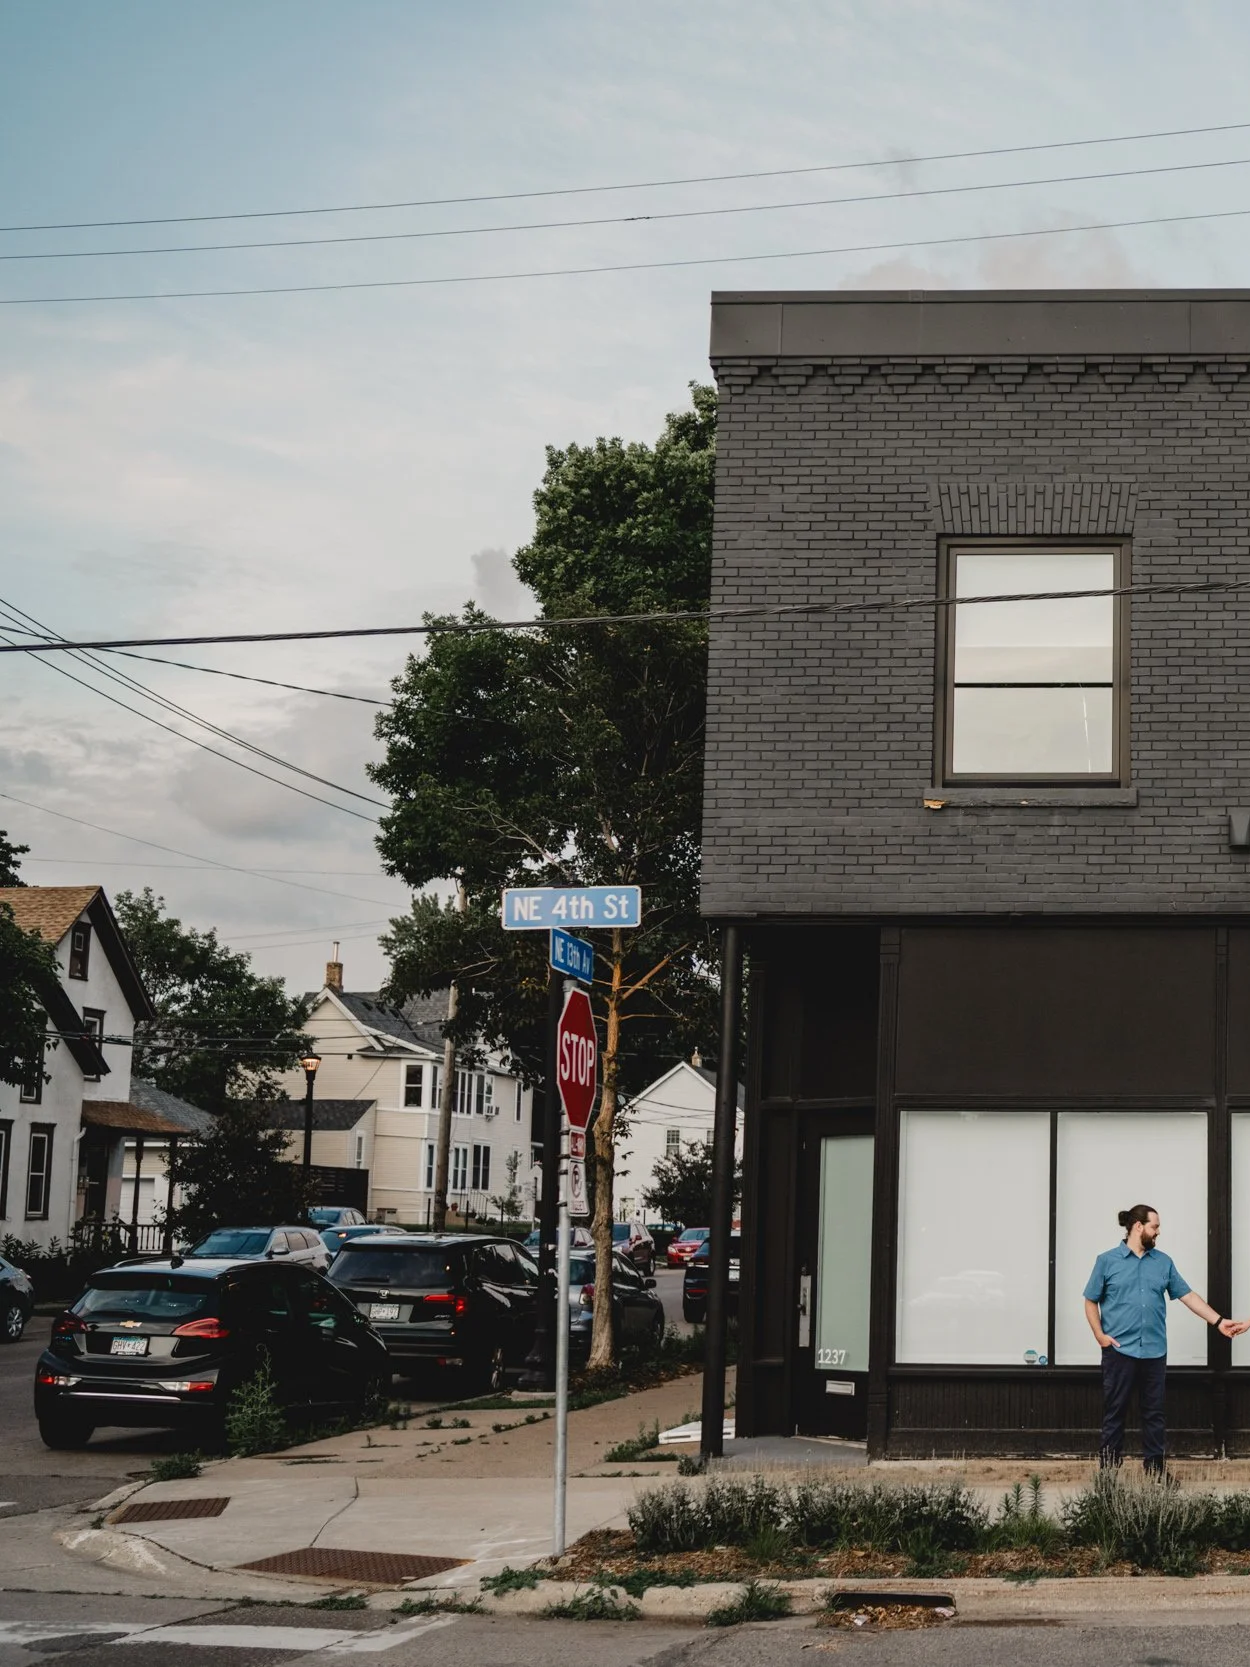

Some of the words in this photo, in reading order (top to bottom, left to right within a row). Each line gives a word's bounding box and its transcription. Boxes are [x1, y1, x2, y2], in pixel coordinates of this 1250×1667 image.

[513, 896, 542, 921] NE
[551, 895, 594, 920] 4th
[603, 894, 629, 919] St
[554, 935, 565, 963] NE
[566, 942, 580, 970] 13th
[560, 1030, 595, 1087] STOP
[817, 1348, 846, 1365] 1237
